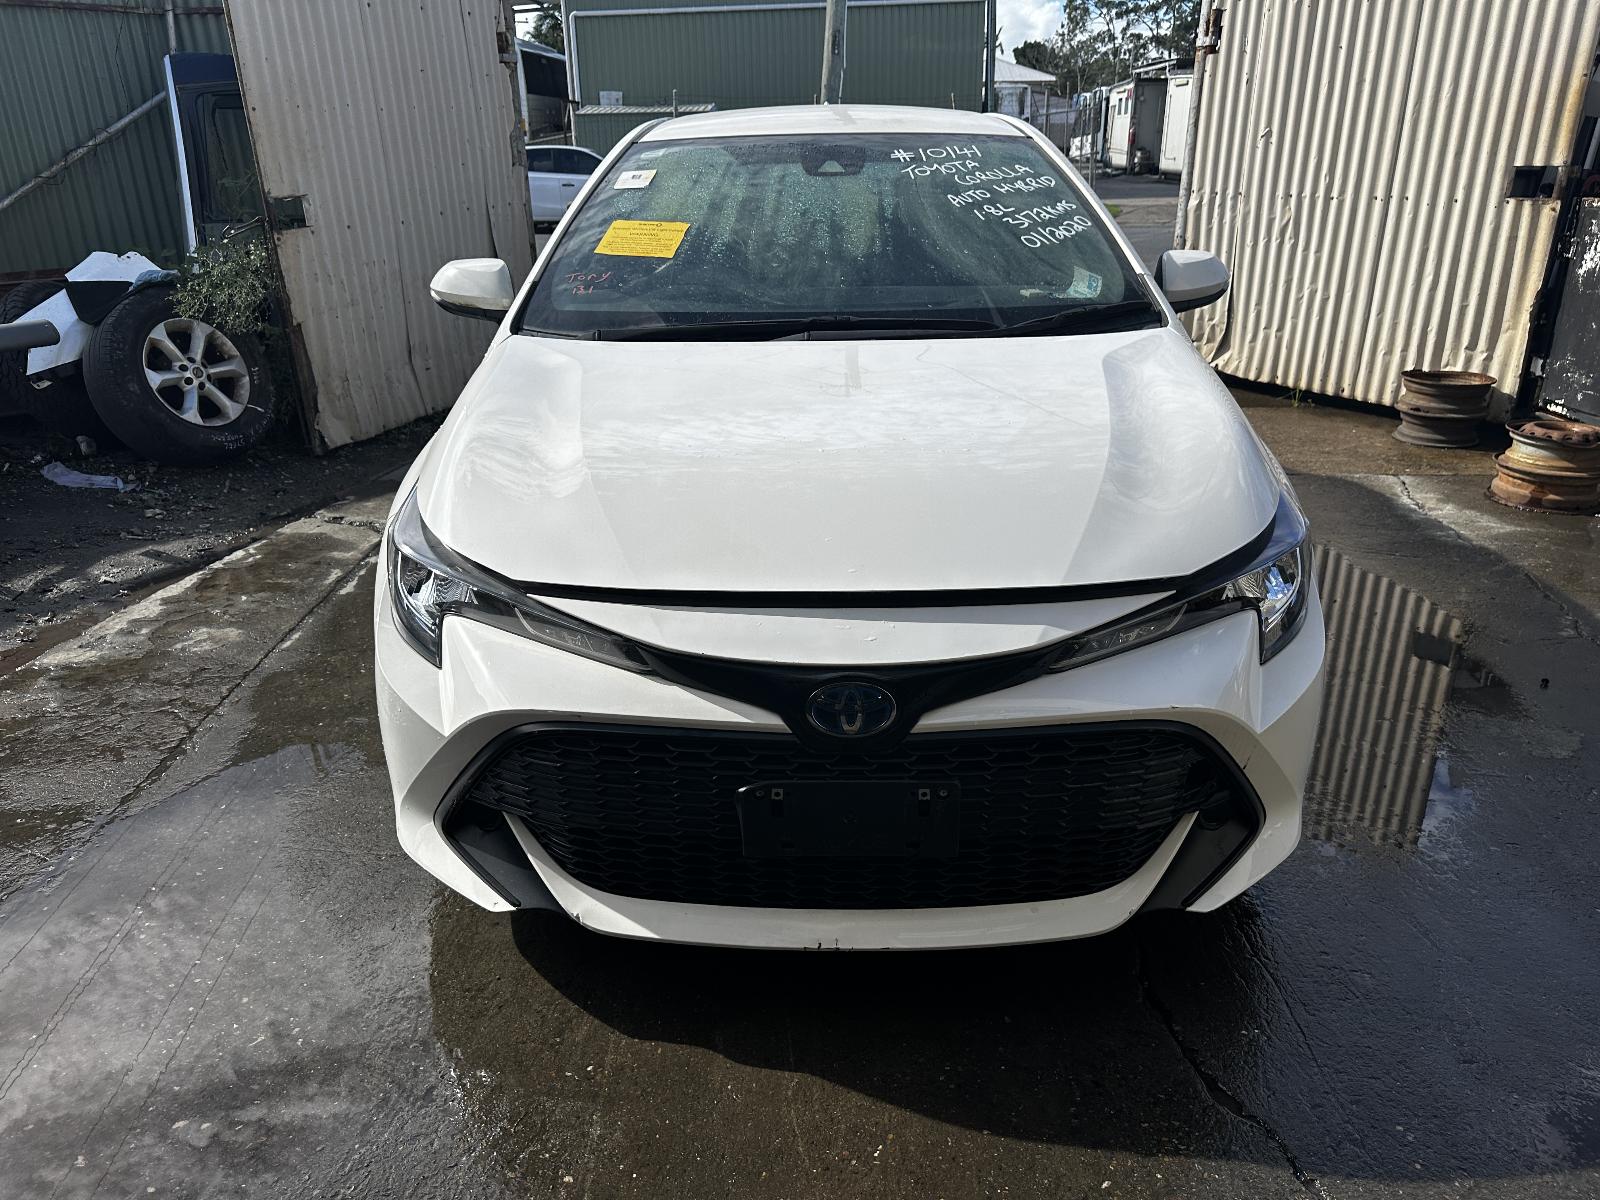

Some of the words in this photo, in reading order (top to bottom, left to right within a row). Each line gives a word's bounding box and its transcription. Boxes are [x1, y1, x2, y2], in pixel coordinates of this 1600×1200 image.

[890, 145, 982, 162] #10141
[901, 160, 980, 179] TOYOTA
[955, 164, 1035, 185] COROLLA
[947, 189, 991, 207] AUTO
[993, 175, 1056, 194] HYBRID
[973, 203, 1015, 220] 1.8L
[1020, 215, 1092, 248] 01/2020
